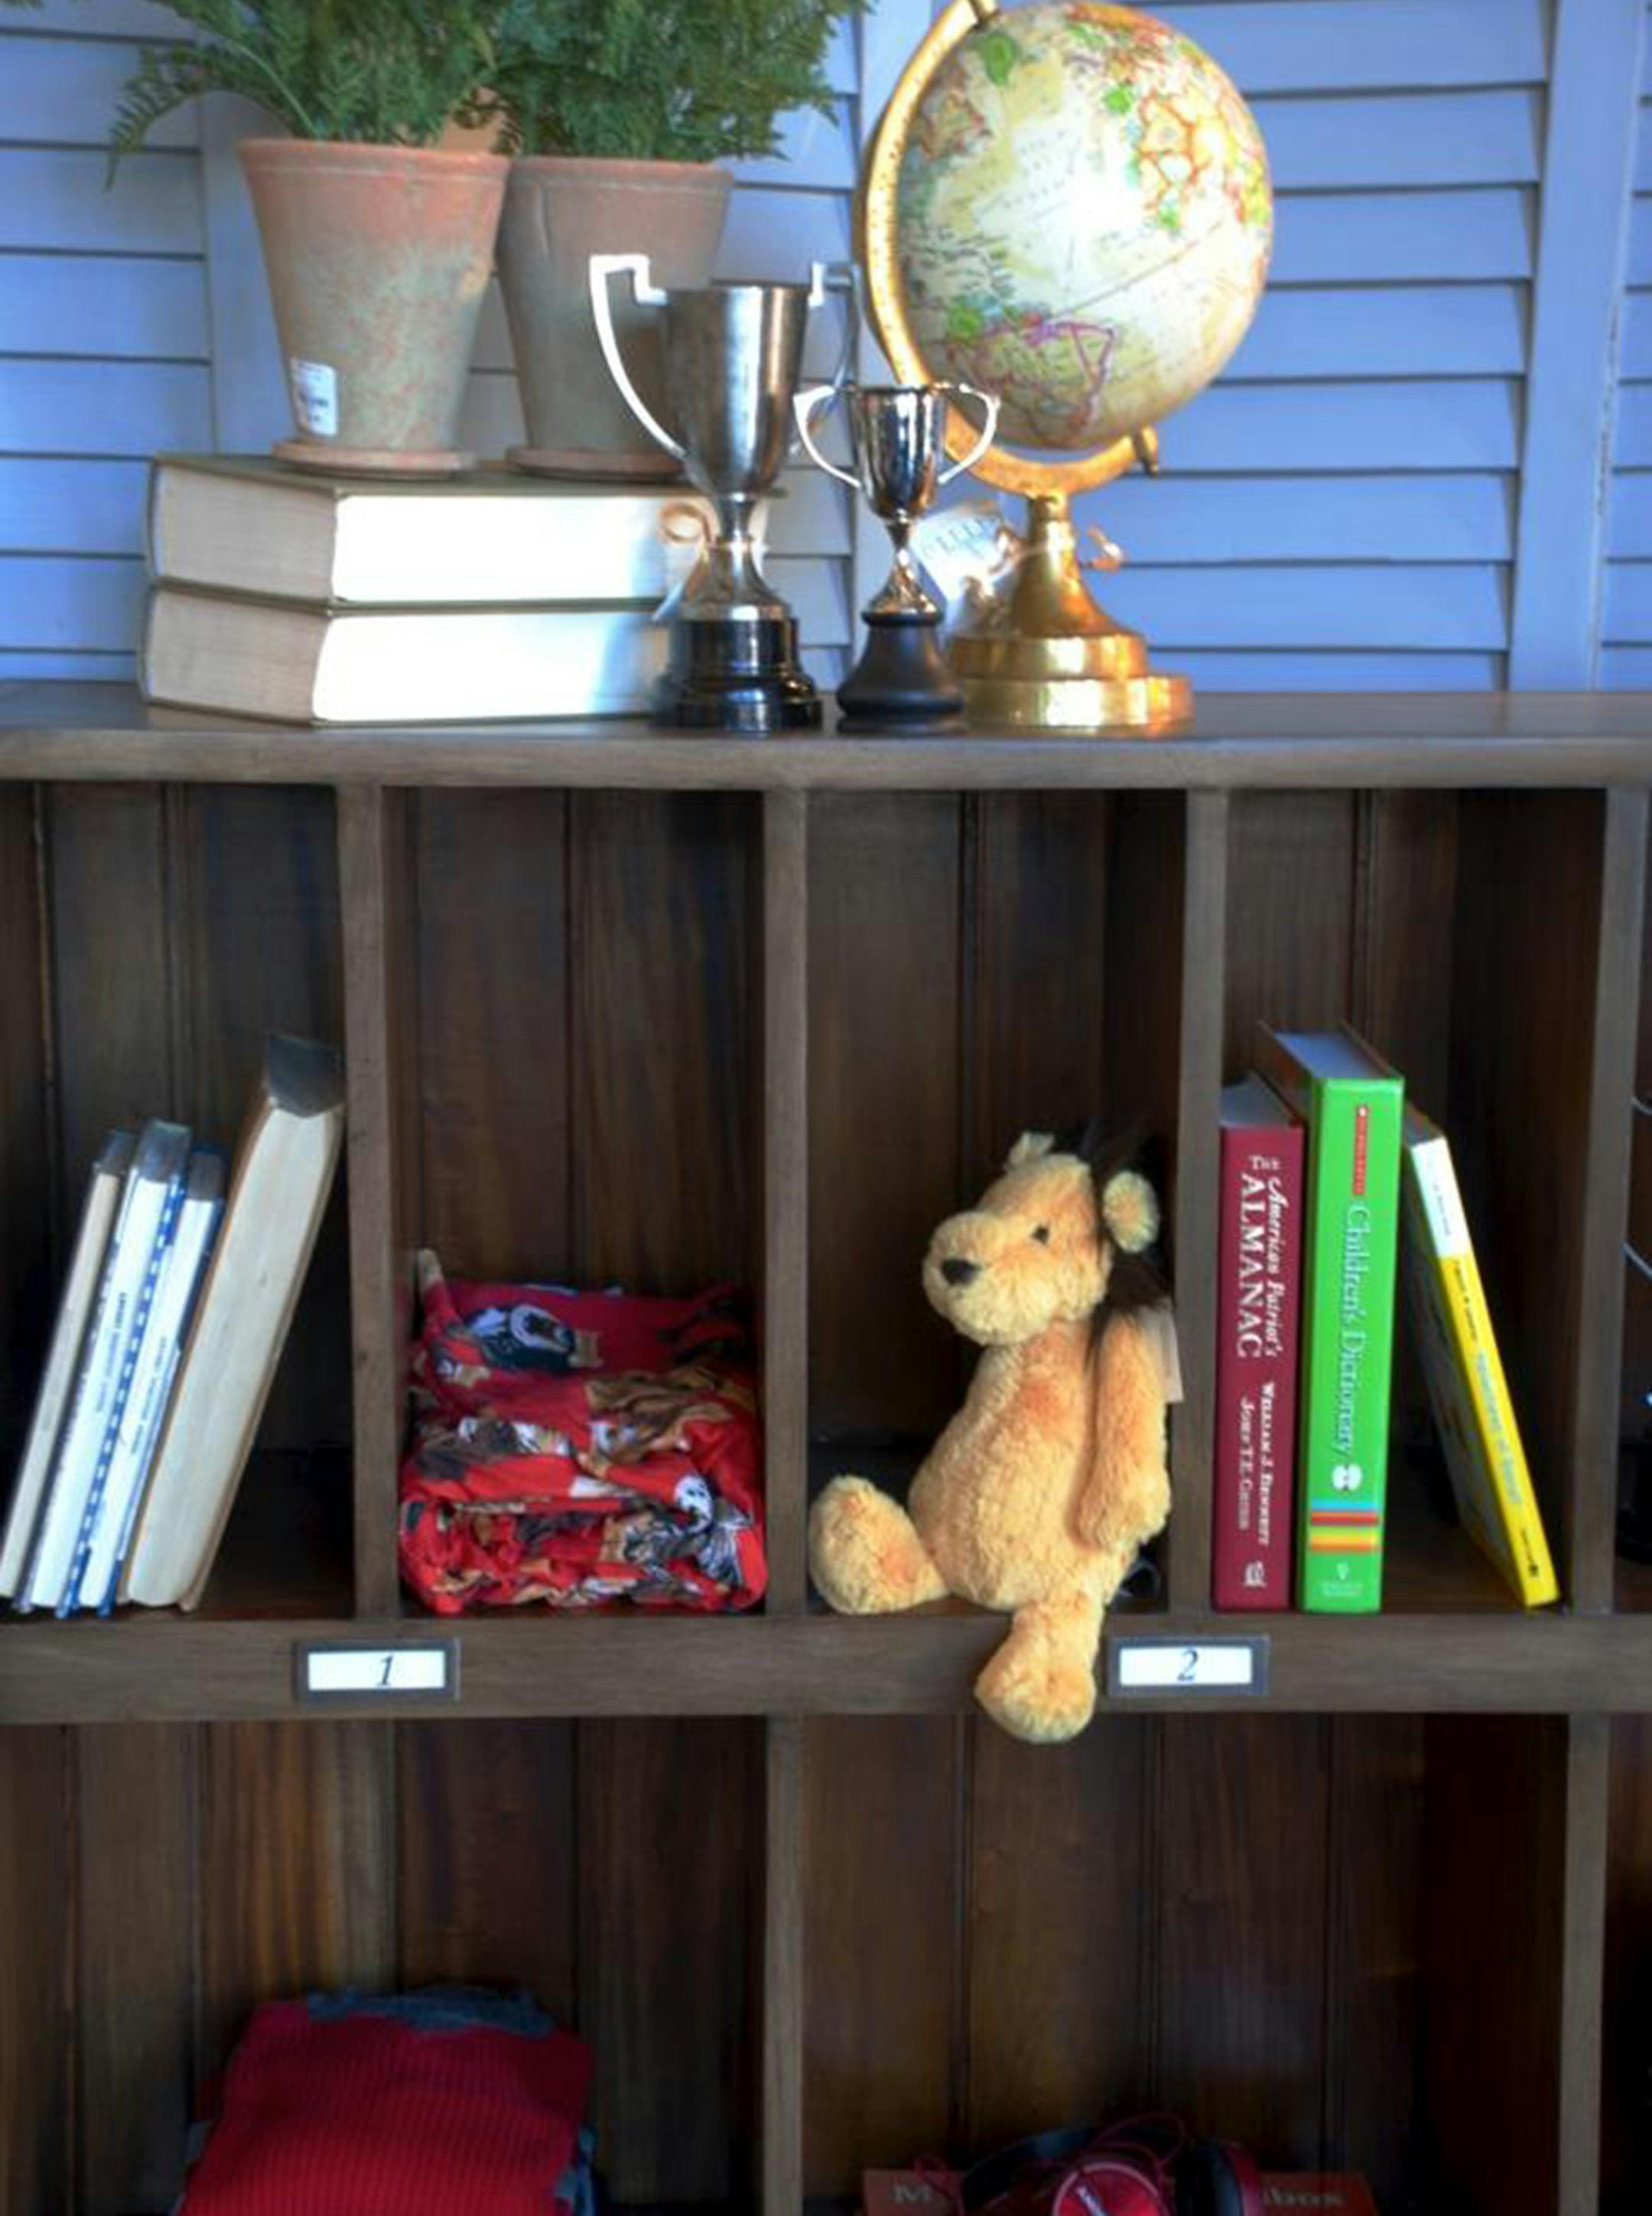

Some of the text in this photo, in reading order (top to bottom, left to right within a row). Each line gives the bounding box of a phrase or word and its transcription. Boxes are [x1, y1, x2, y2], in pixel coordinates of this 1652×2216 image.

[1237, 1173, 1266, 1359] ALMANAC
[1265, 1176, 1289, 1357] American Patriot's
[1342, 1206, 1371, 1326] Children's
[1332, 1330, 1367, 1456] Dictionary
[376, 1654, 394, 1687] 1
[1176, 1648, 1198, 1681] 2
